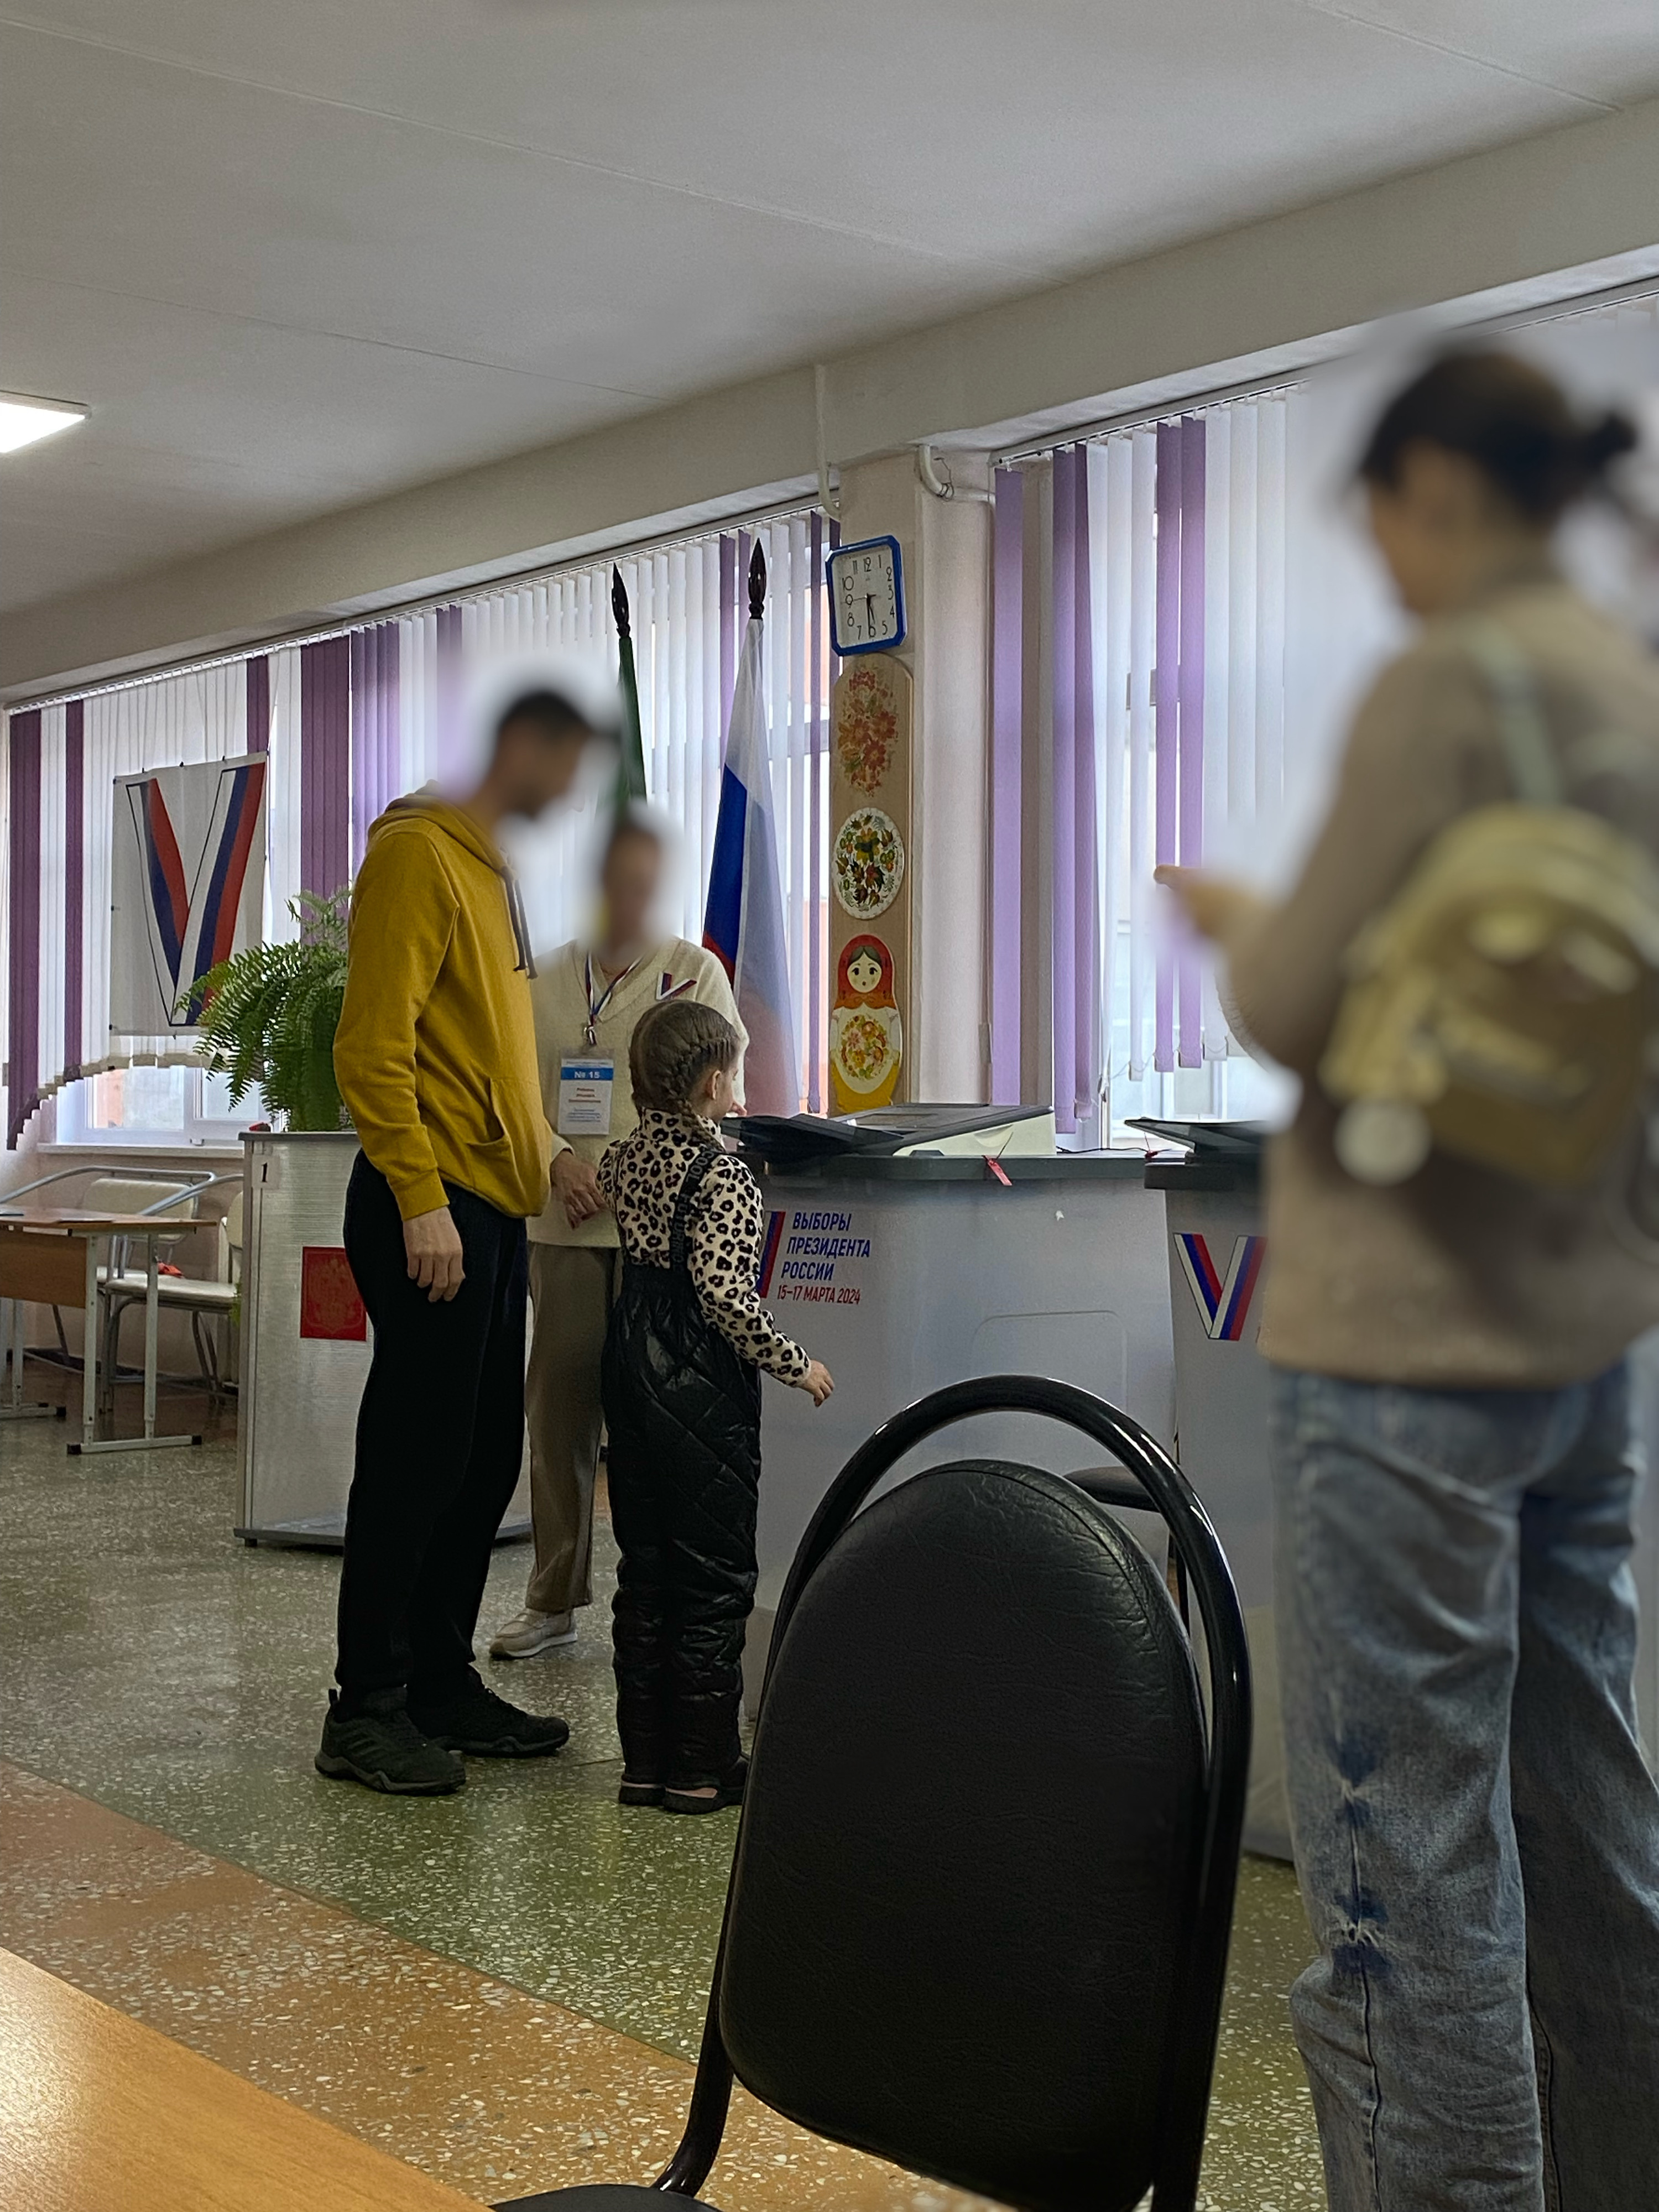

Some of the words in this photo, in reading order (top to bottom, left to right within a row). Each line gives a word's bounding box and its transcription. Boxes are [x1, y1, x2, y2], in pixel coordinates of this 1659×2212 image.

[864, 557, 871, 572] 12
[878, 555, 881, 568] 1
[886, 566, 892, 581] 2
[842, 576, 854, 591] 10
[888, 585, 894, 600] 3
[845, 594, 853, 608] 9
[847, 612, 854, 627] 8
[890, 606, 895, 618] 4
[857, 625, 862, 640] 7
[869, 625, 877, 638] 6
[882, 620, 888, 635] 5
[262, 1162, 268, 1182] 1
[792, 1212, 852, 1232] ВЫБОРЫ
[786, 1237, 871, 1259] ПРЕЗИДЕНТА
[781, 1261, 835, 1281] РОССИИ
[804, 1286, 836, 1303] МАРТА
[837, 1288, 860, 1305] 2024
